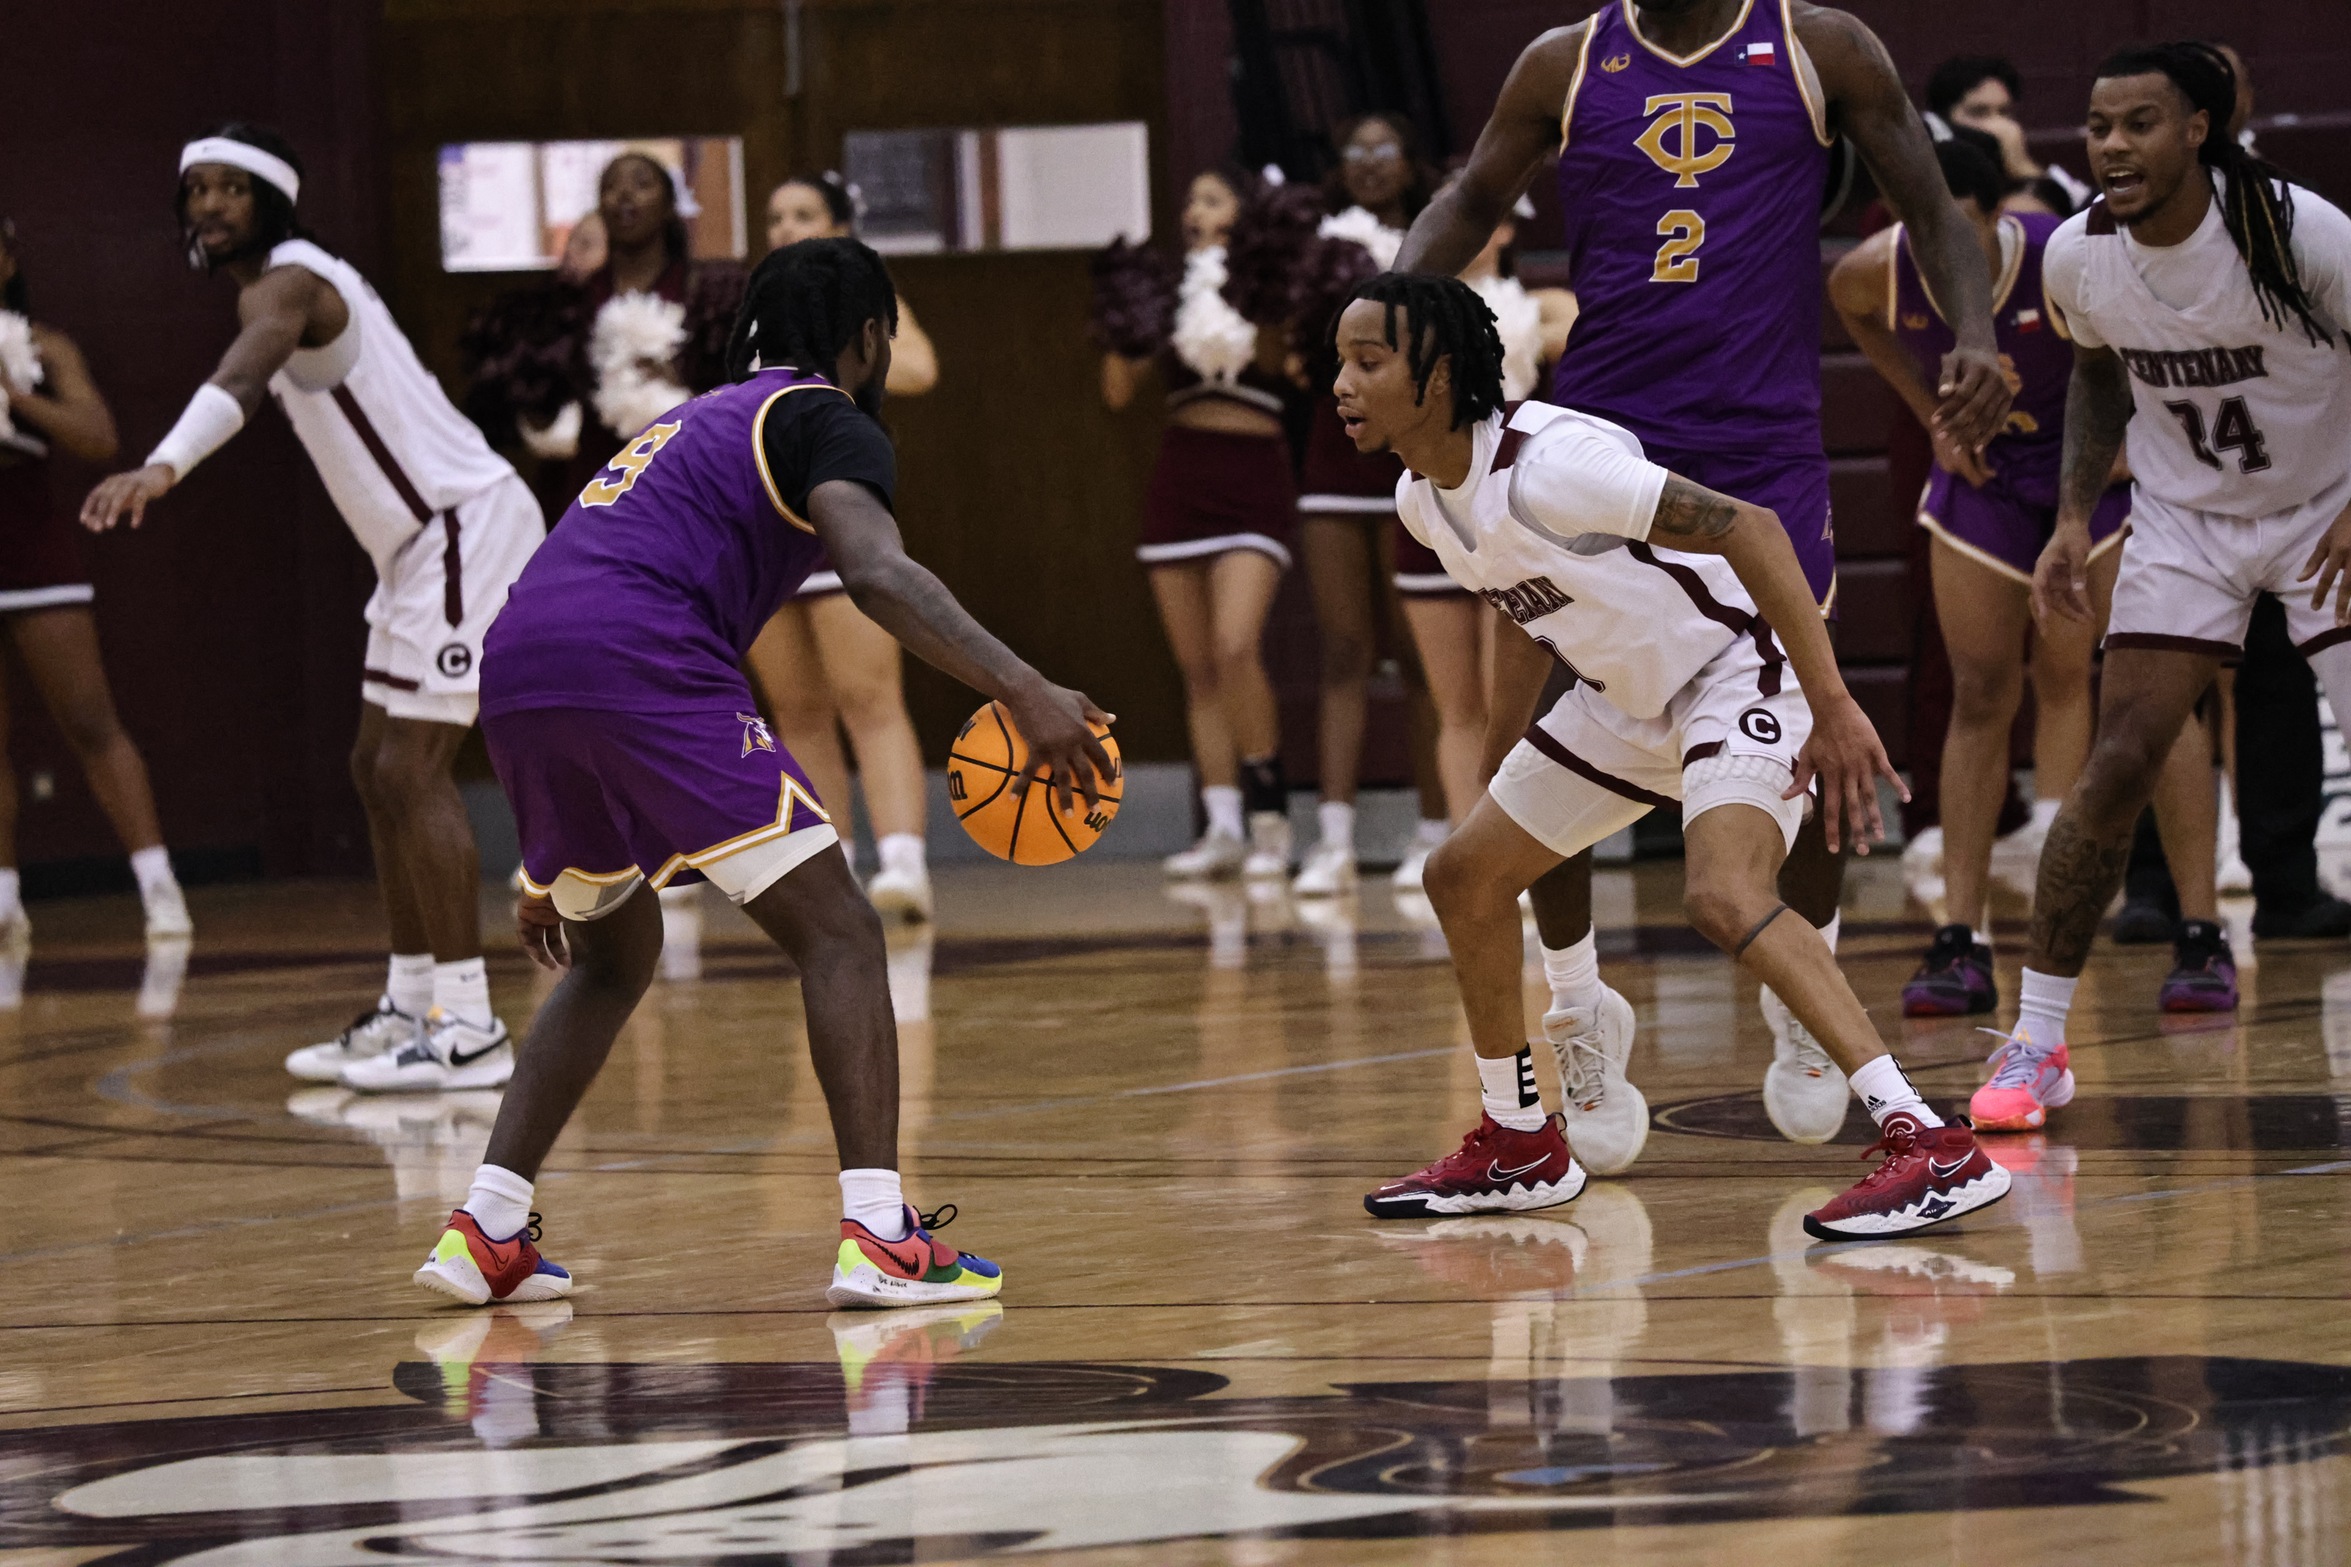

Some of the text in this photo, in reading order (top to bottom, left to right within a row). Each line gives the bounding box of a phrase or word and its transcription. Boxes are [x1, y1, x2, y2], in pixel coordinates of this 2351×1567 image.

[1649, 209, 1706, 283] 2
[579, 419, 682, 509] 9
[441, 646, 468, 675] C
[1744, 711, 1777, 742] C
